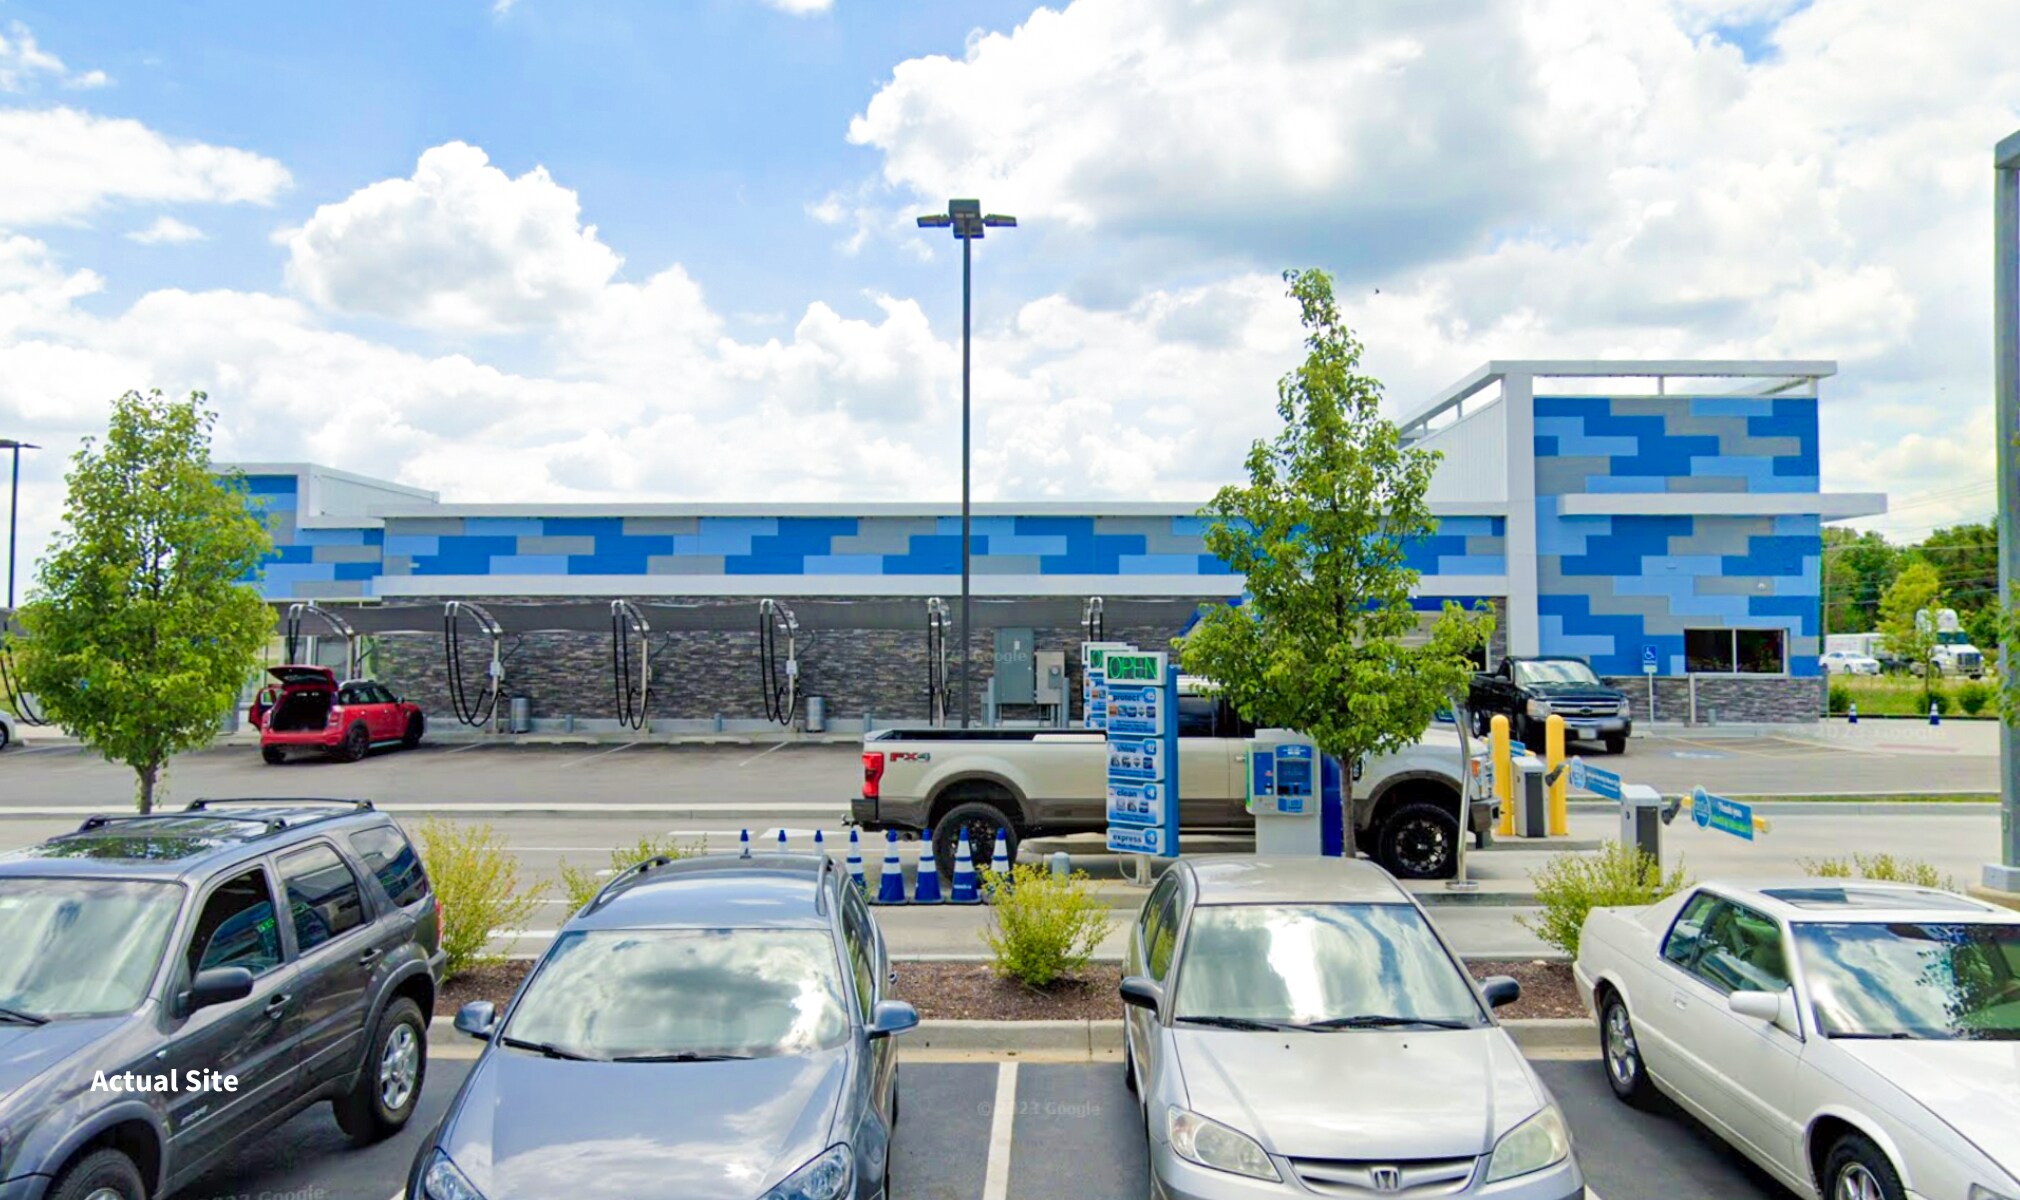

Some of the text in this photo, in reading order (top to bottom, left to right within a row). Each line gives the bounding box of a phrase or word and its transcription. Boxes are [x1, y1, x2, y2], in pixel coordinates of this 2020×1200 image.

[1108, 656, 1157, 680] OPEN
[1112, 693, 1140, 702] protect
[890, 752, 931, 762] FX4
[1116, 788, 1138, 798] clean
[1112, 834, 1142, 843] express
